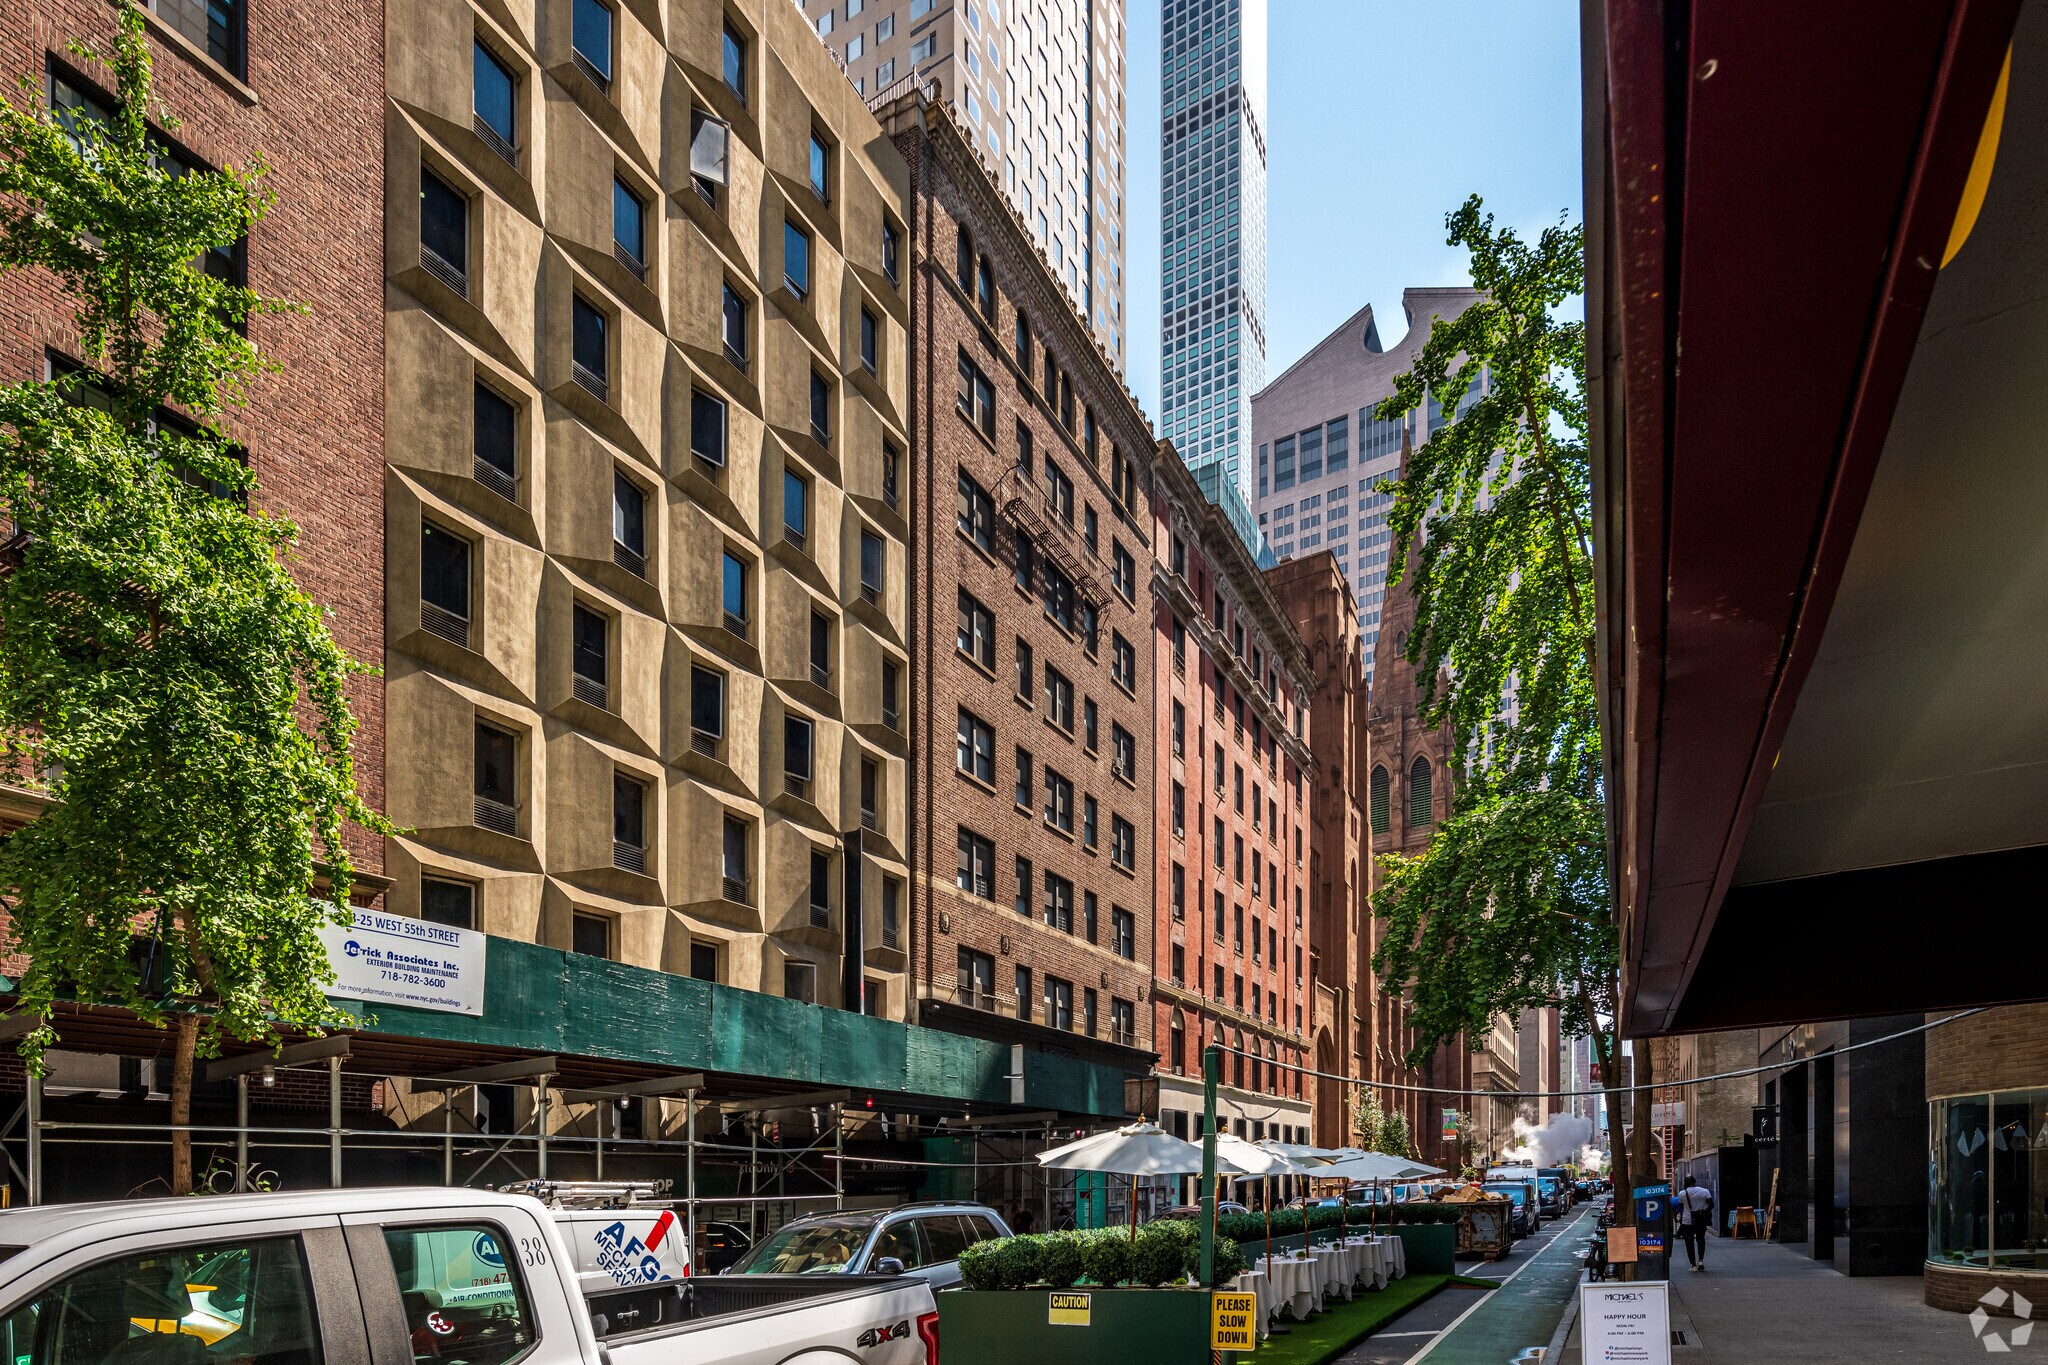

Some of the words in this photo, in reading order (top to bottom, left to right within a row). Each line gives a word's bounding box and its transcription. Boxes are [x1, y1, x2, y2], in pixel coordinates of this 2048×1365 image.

[375, 916, 402, 932] WEST
[405, 923, 425, 936] 55th
[428, 928, 460, 942] STREET
[344, 941, 381, 958] Jerrick
[387, 951, 438, 967] Associates
[444, 961, 459, 970] Inc.
[367, 958, 393, 969] EXTERIOR
[395, 962, 420, 972] BUILDING
[421, 966, 458, 979] MAINTENANCE
[381, 970, 445, 988] 718-782-3600
[406, 994, 460, 1007] www.nyc.gov/buildings
[755, 1161, 778, 1175] Only
[1646, 1201, 1658, 1218] P
[521, 1237, 546, 1266] 38
[594, 1231, 646, 1283] MECHAN
[597, 1252, 632, 1286] SERV
[493, 1273, 510, 1284] 47
[1052, 1296, 1088, 1309] CAUTION
[1216, 1299, 1250, 1310] PLEASE
[1220, 1315, 1246, 1327] SLOW
[1217, 1332, 1247, 1344] DOWN
